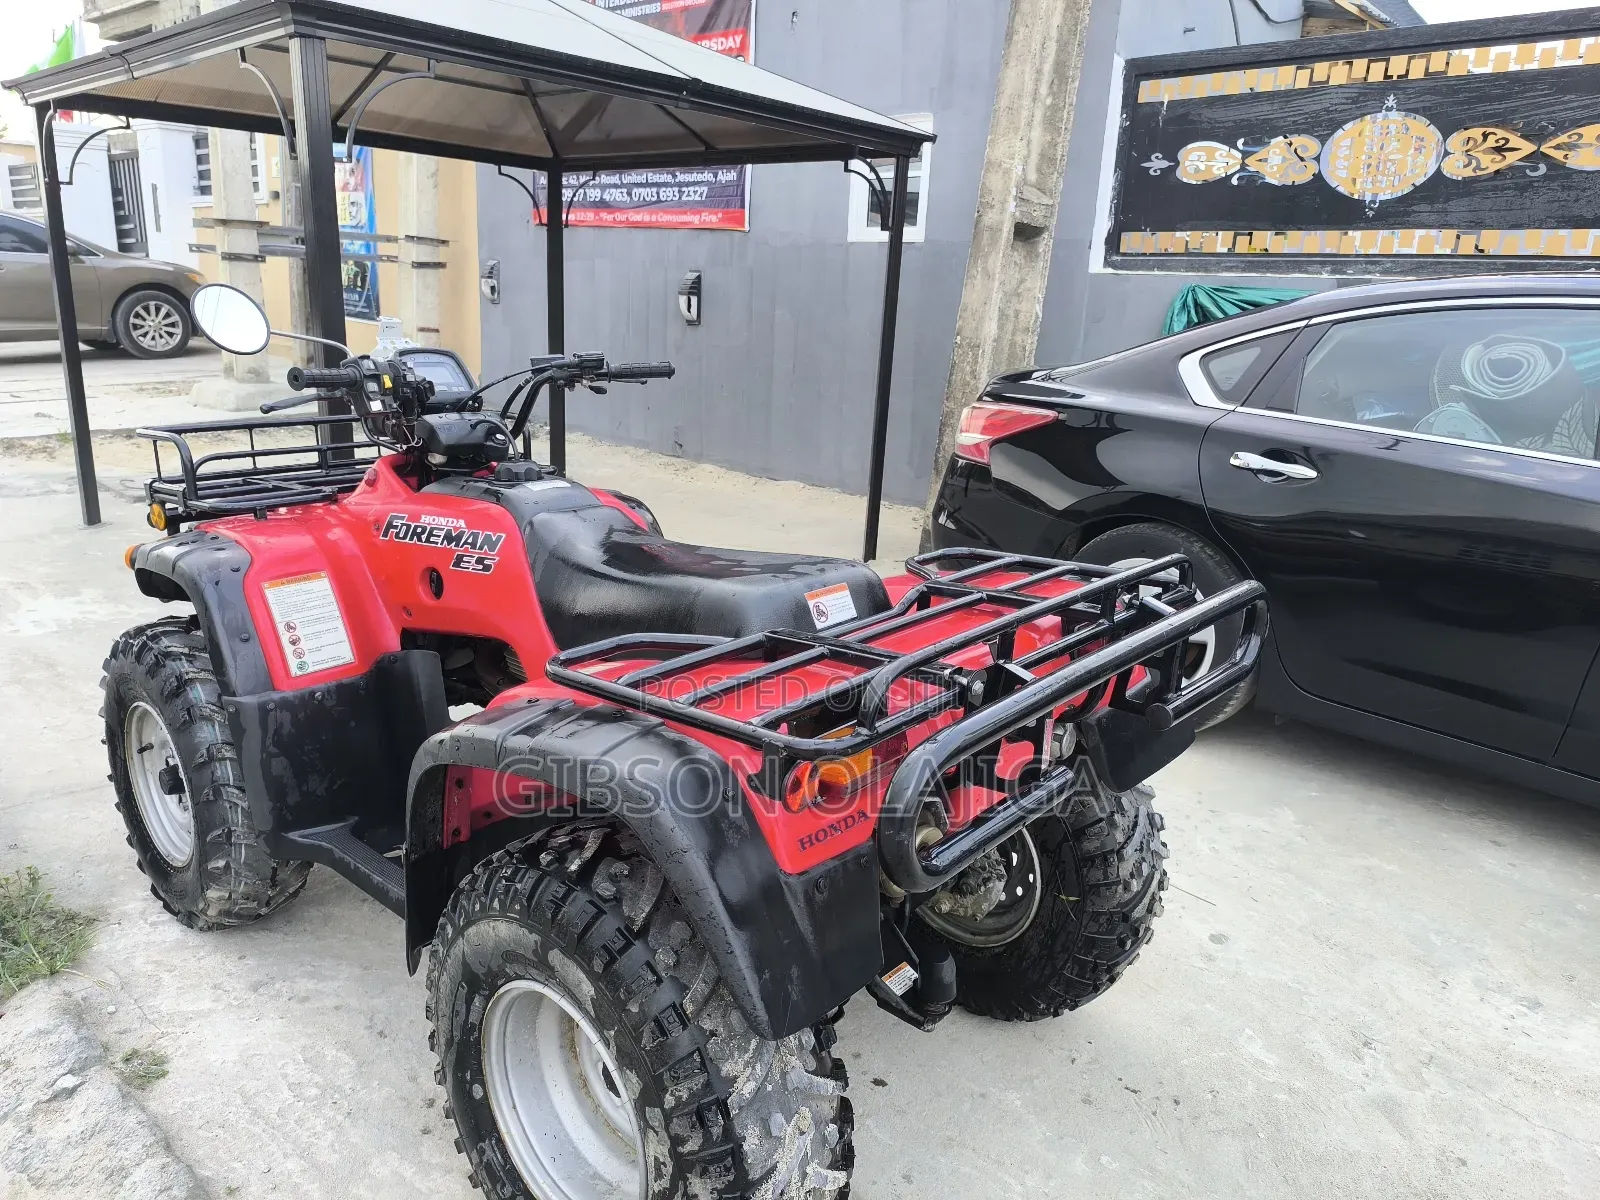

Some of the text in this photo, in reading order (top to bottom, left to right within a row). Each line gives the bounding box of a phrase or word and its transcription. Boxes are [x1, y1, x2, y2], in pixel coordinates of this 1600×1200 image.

[622, 3, 661, 18] MINISTRIES
[698, 34, 743, 52] RSDAY
[600, 174, 621, 186] Road,
[621, 172, 646, 184] United
[647, 171, 674, 185] Estate,
[675, 170, 715, 184] Jesutedo,
[717, 169, 737, 184] Ajah
[585, 188, 602, 202] 199
[602, 187, 630, 203] 4763,
[632, 187, 657, 202] 0703
[659, 187, 679, 201] 693
[681, 186, 708, 201] 2327
[615, 212, 628, 222] Our
[628, 212, 643, 222] God
[643, 212, 651, 222] is
[657, 212, 700, 224] Consuming
[419, 514, 467, 528] HONDA
[449, 551, 500, 575] ES
[797, 809, 871, 852] HONDA
